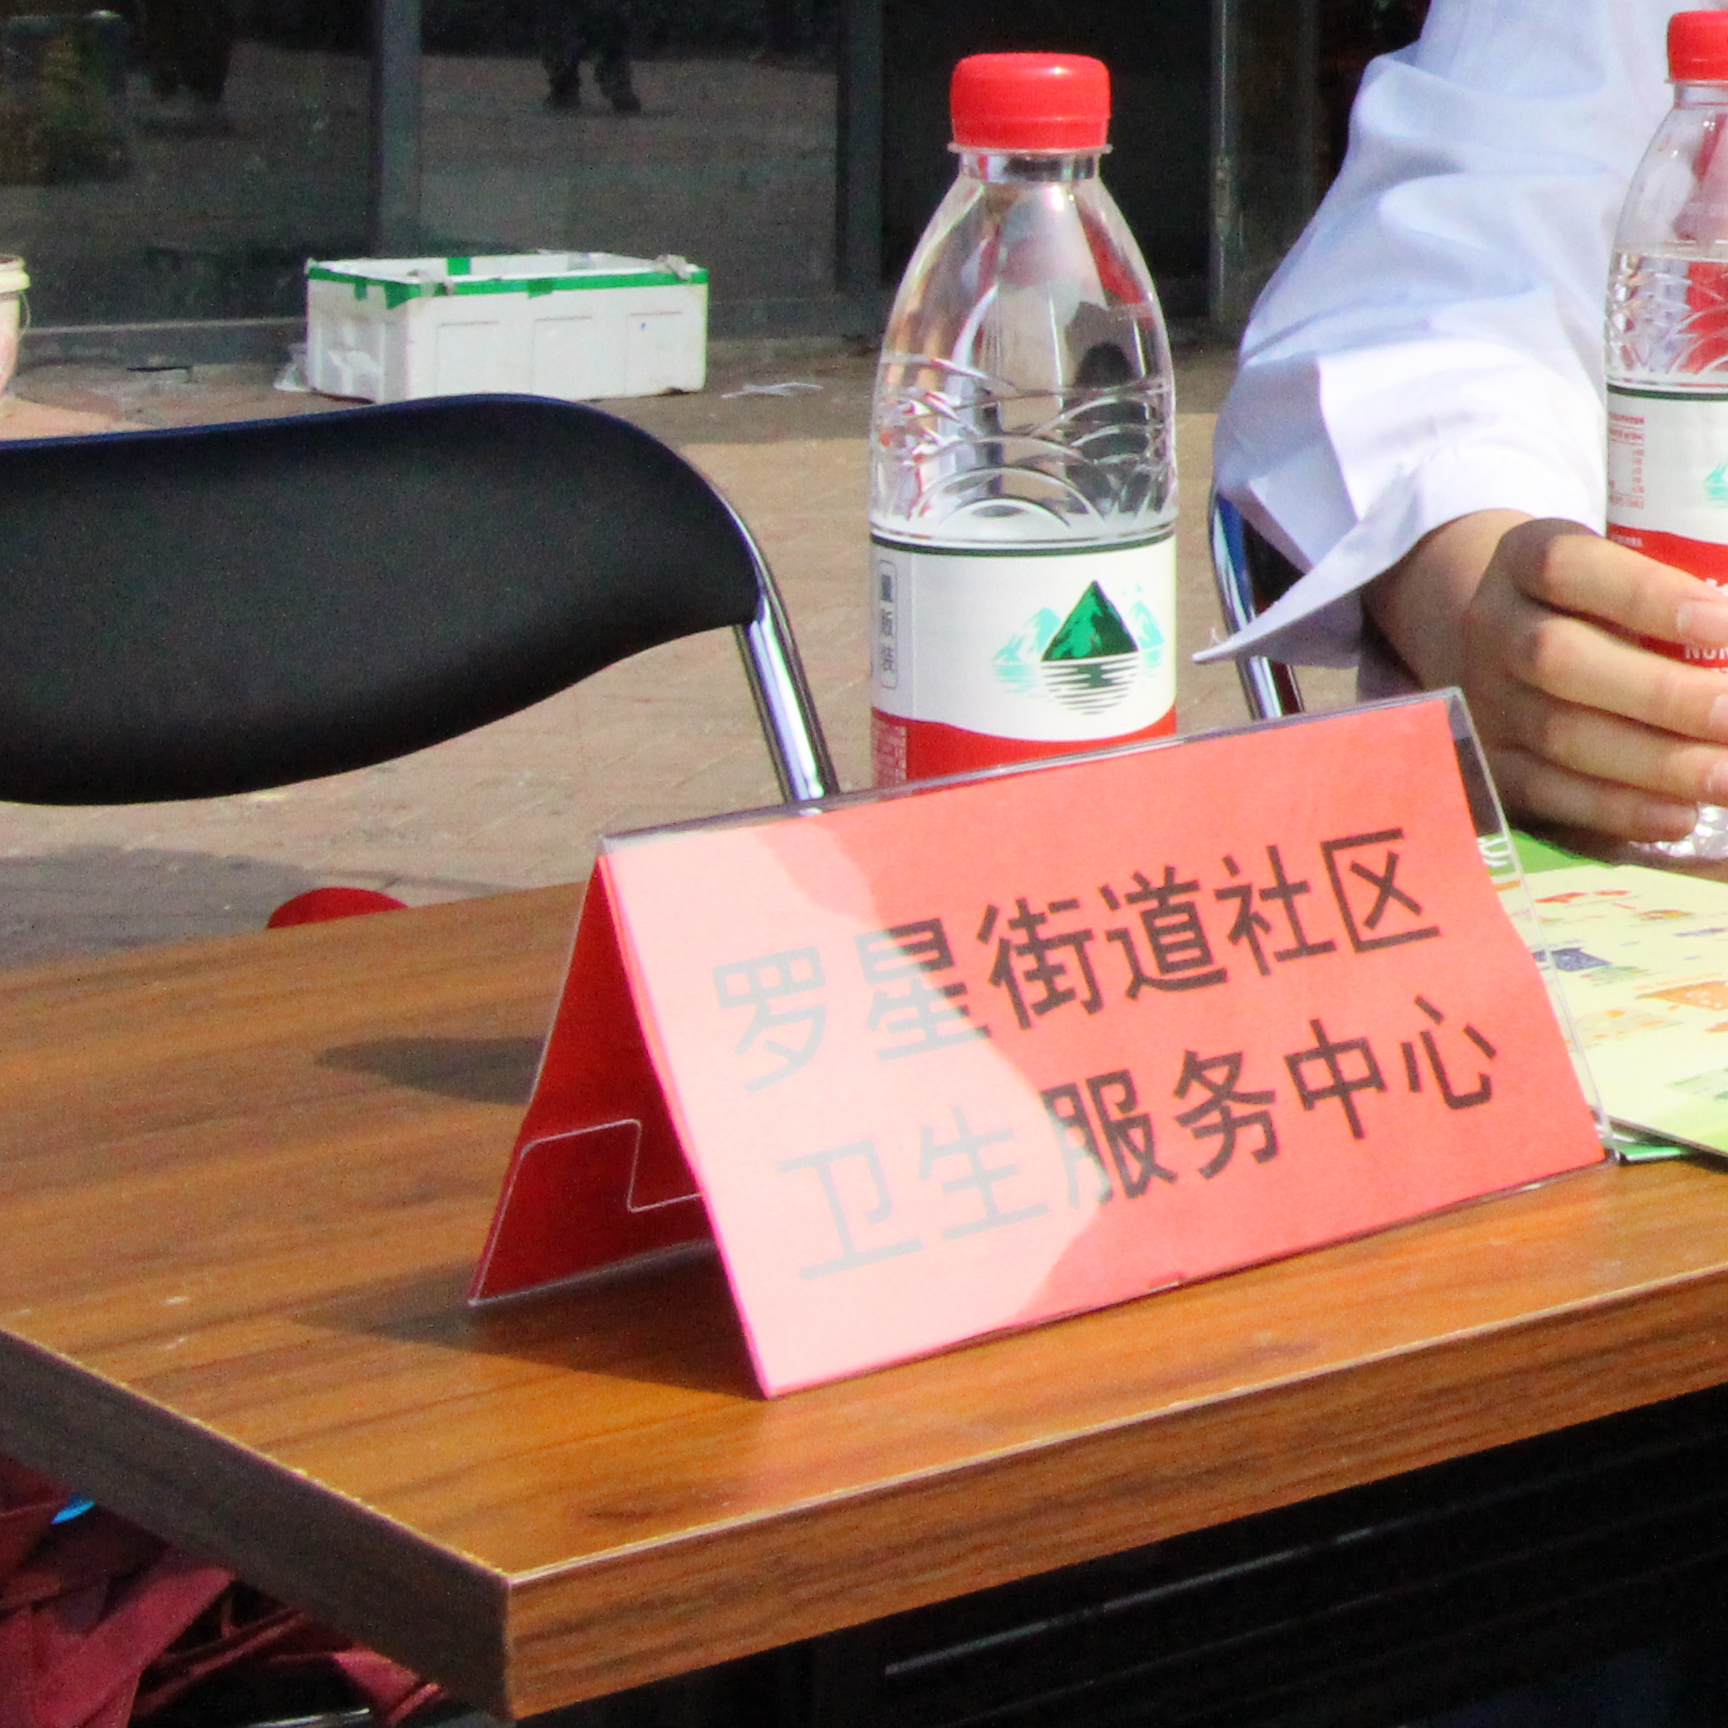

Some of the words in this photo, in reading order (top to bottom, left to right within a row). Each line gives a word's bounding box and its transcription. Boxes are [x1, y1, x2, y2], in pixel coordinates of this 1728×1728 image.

[712, 829, 1440, 1094] 罗星街道社区
[776, 994, 1499, 1283] 卫生服务中心
